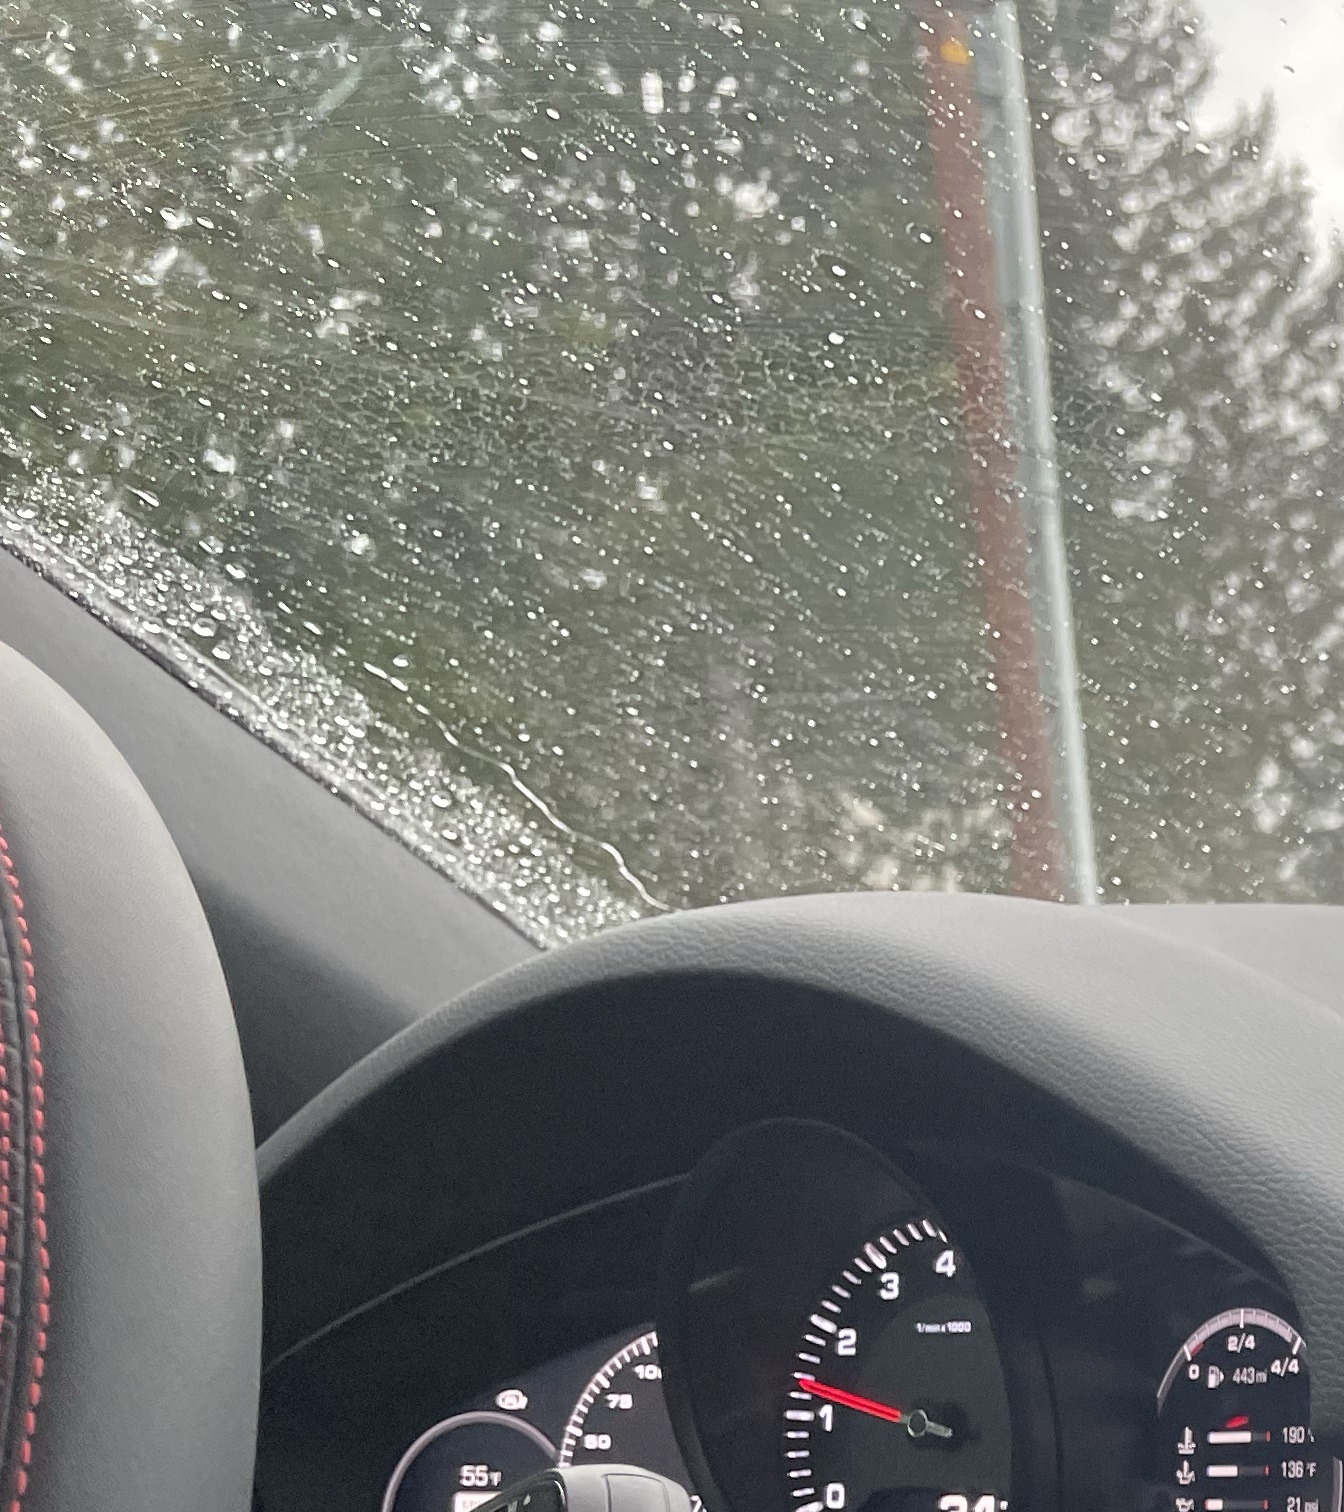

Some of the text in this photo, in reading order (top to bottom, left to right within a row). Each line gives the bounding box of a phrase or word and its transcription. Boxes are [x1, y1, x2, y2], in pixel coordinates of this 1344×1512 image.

[935, 1249, 957, 1278] 4
[879, 1272, 900, 1300] 3
[836, 1328, 857, 1356] 2
[1227, 1333, 1256, 1354] 2/4
[1188, 1363, 1200, 1380] 0
[1270, 1357, 1300, 1377] 4/4
[819, 1403, 834, 1433] 1
[1281, 1459, 1304, 1479] 136
[825, 1482, 846, 1510] 0
